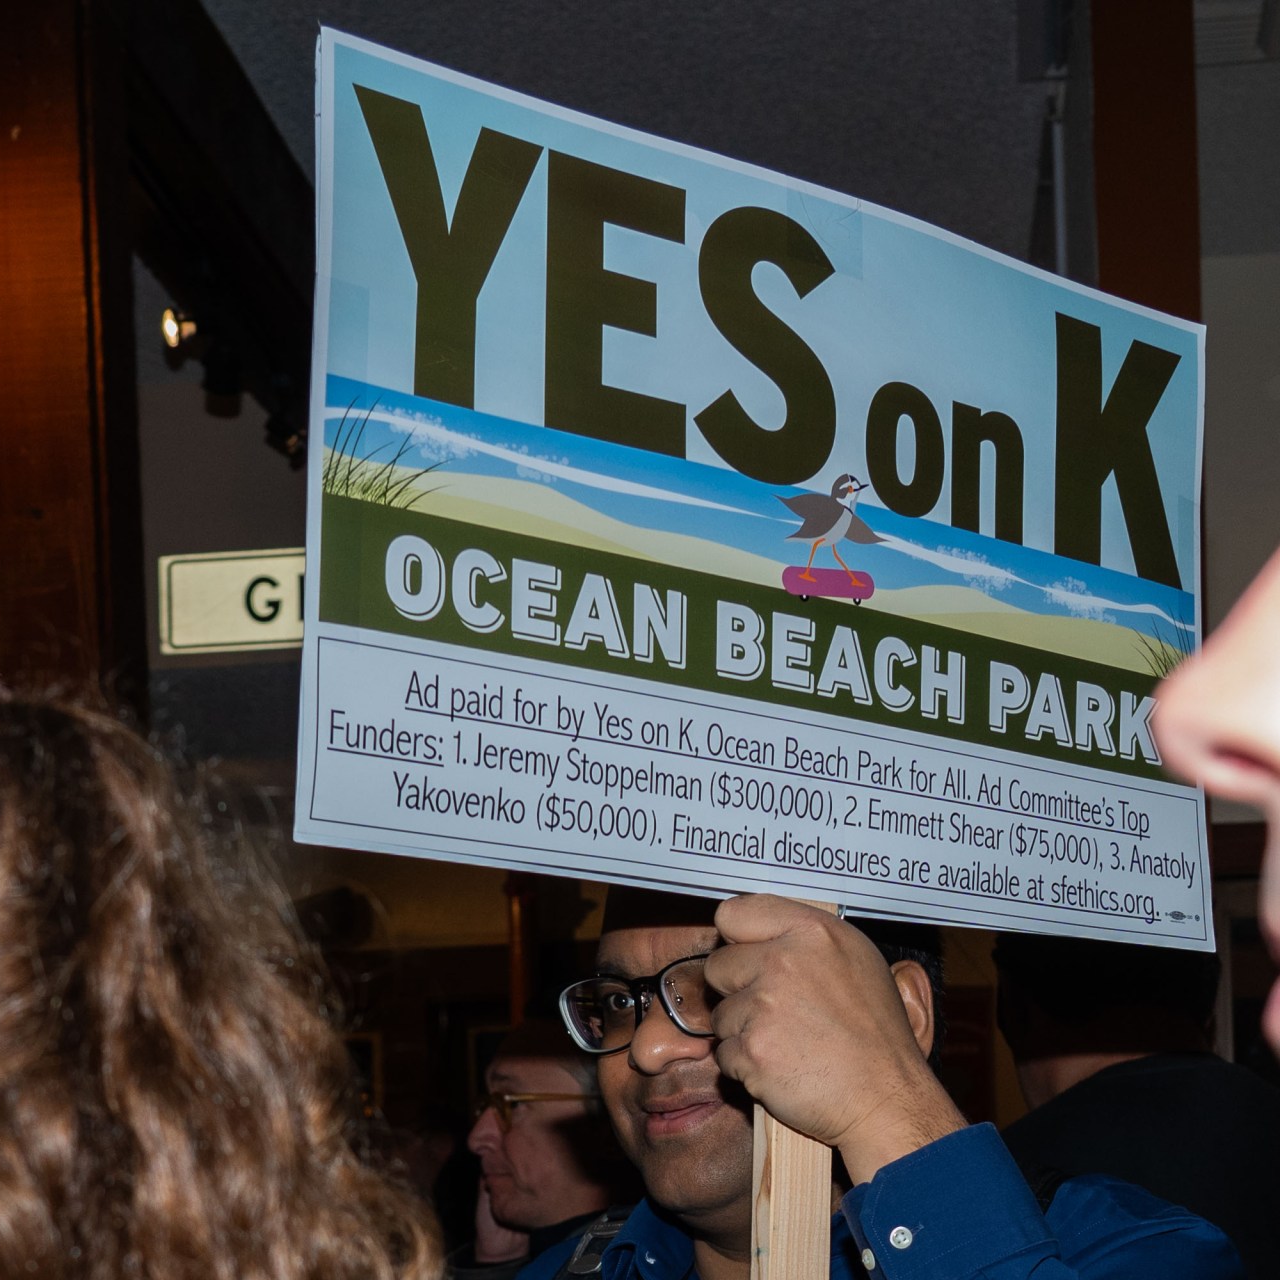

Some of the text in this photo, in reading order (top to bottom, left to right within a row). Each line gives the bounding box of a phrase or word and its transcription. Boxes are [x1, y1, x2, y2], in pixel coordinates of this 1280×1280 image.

[352, 83, 1183, 590] YES on K
[385, 534, 1163, 766] OCEAN BEACH PARK
[327, 709, 1195, 889] Funders: 1. Jeremy Stoppelman ($300,000), 2. Emmett Shear ($75,000), 3. Anatoly
[405, 670, 1150, 841] Ad paid for by Yes on K, Ocean Beach Park for All. Ad Committee's Top
[392, 770, 1161, 924] Yakovenko ($50,000). Financial disclosures are available at sfethics.org.
